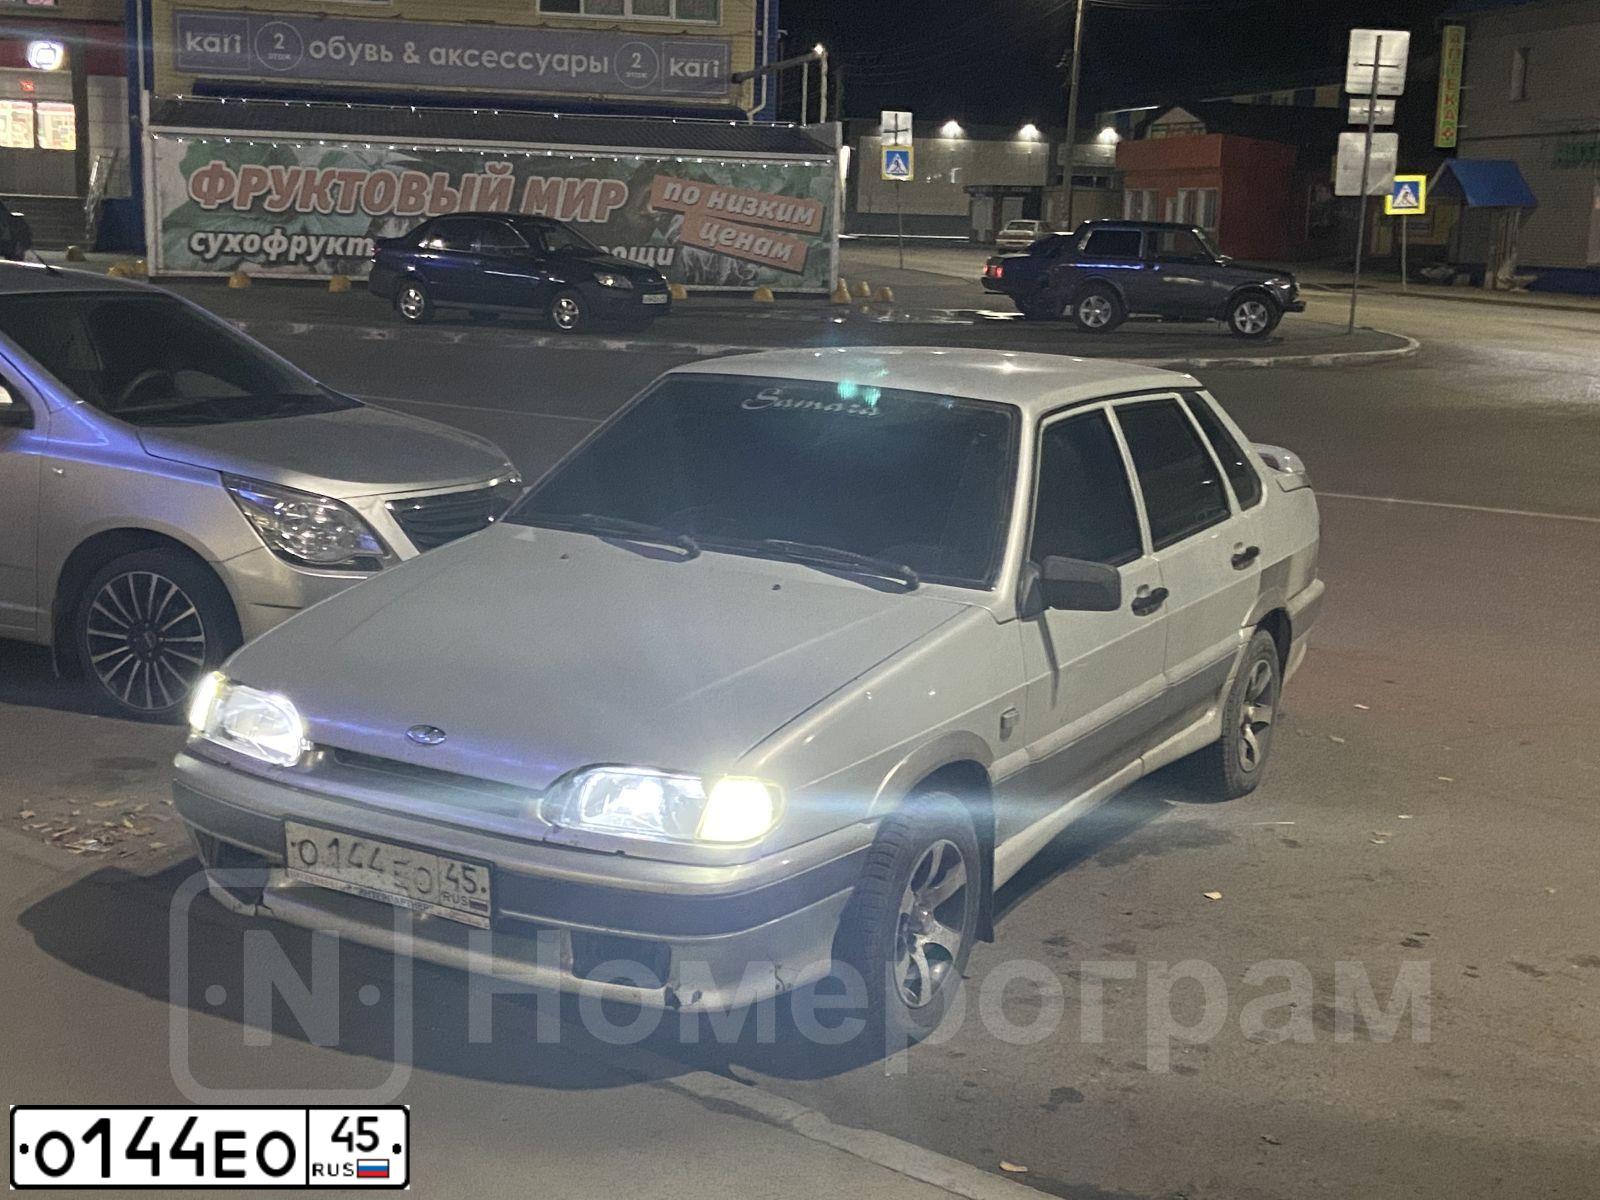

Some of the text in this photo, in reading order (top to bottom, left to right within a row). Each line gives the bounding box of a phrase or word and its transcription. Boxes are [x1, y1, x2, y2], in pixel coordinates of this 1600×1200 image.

[186, 31, 241, 54] kari
[273, 33, 285, 49] 2
[309, 36, 608, 77] обувь & аксессуары
[631, 52, 642, 69] 2
[669, 57, 719, 78] kari
[188, 160, 628, 223] ФРУКТОВЫЙ МИР
[664, 182, 816, 227] по низким
[190, 228, 375, 262] сухофрукт
[701, 221, 793, 264] ценам
[444, 862, 478, 894] 45
